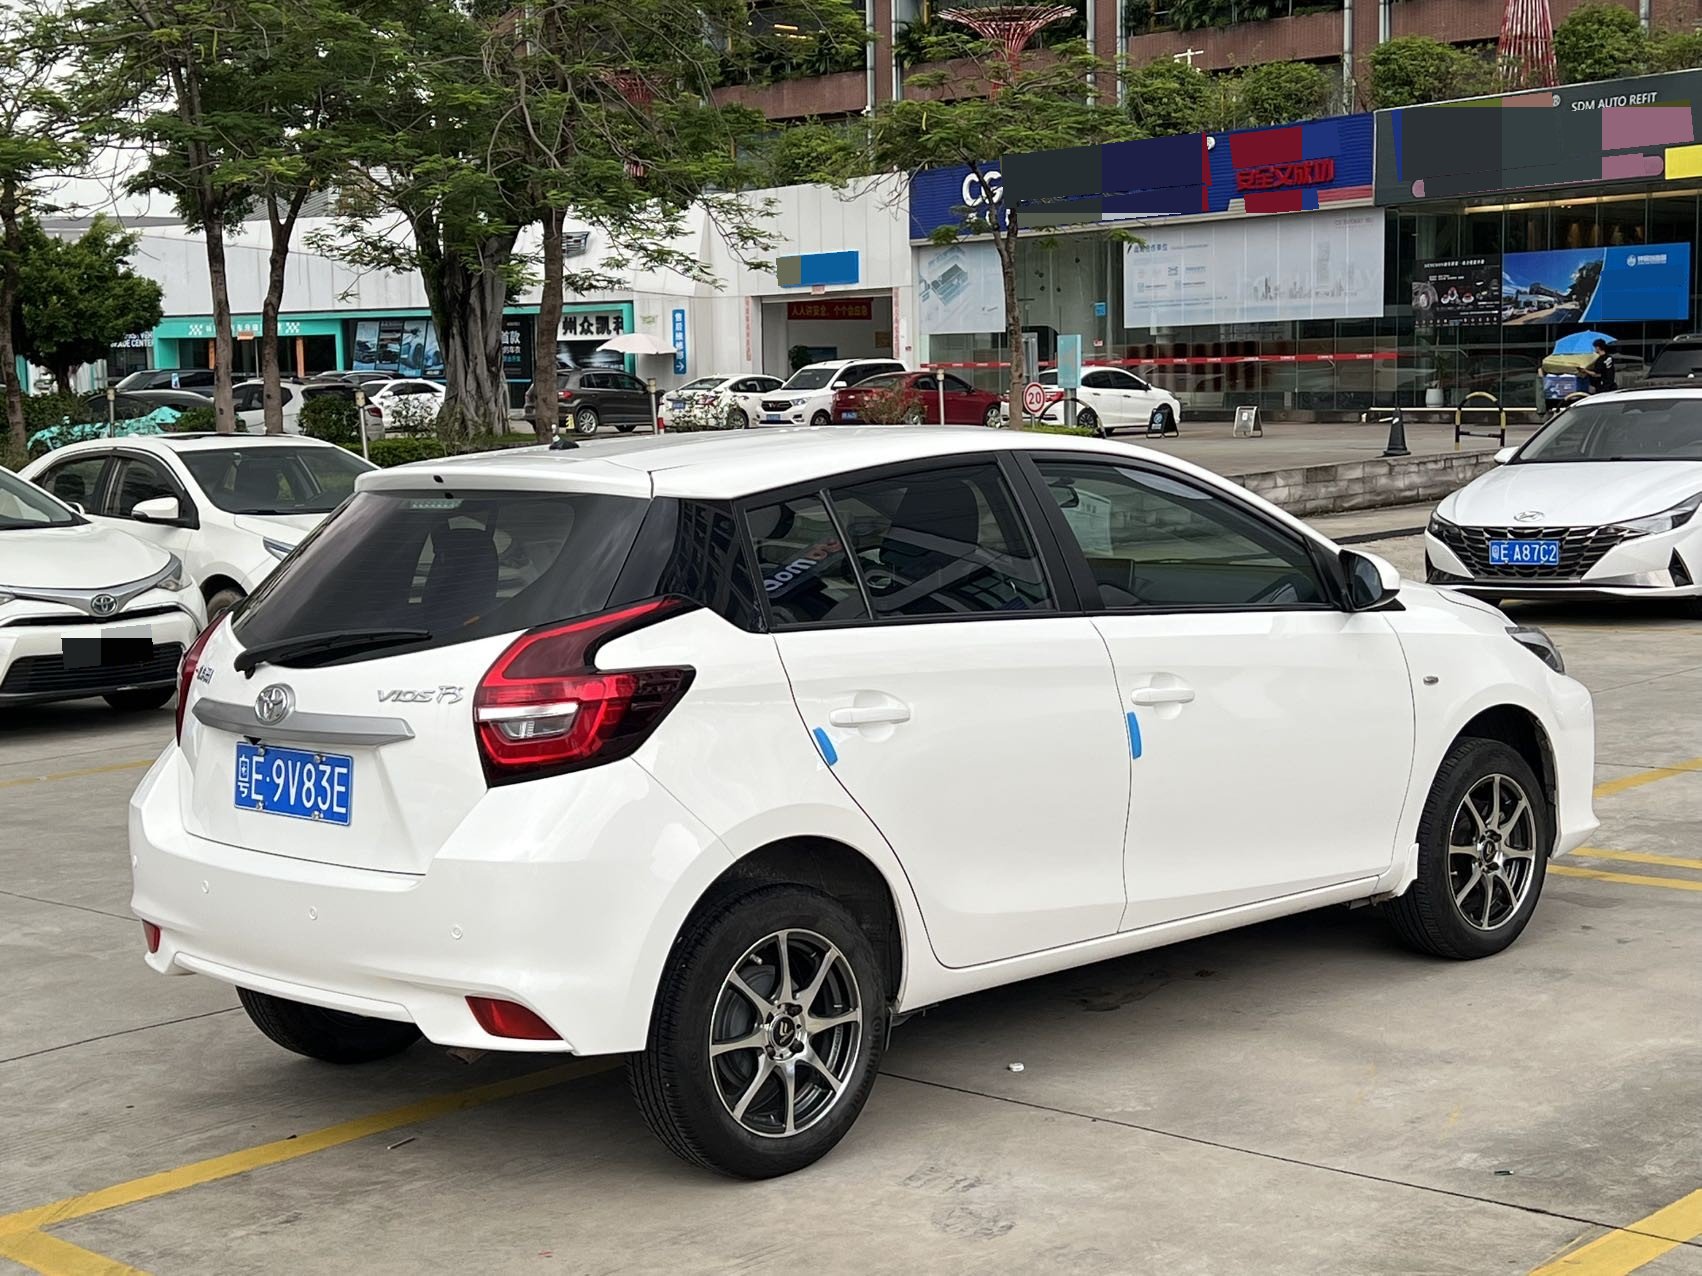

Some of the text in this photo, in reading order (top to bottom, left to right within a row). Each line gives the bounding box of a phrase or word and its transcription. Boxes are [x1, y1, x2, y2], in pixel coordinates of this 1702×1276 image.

[1571, 91, 1658, 112] SDM AUTO REFIT
[1028, 391, 1042, 405] 20
